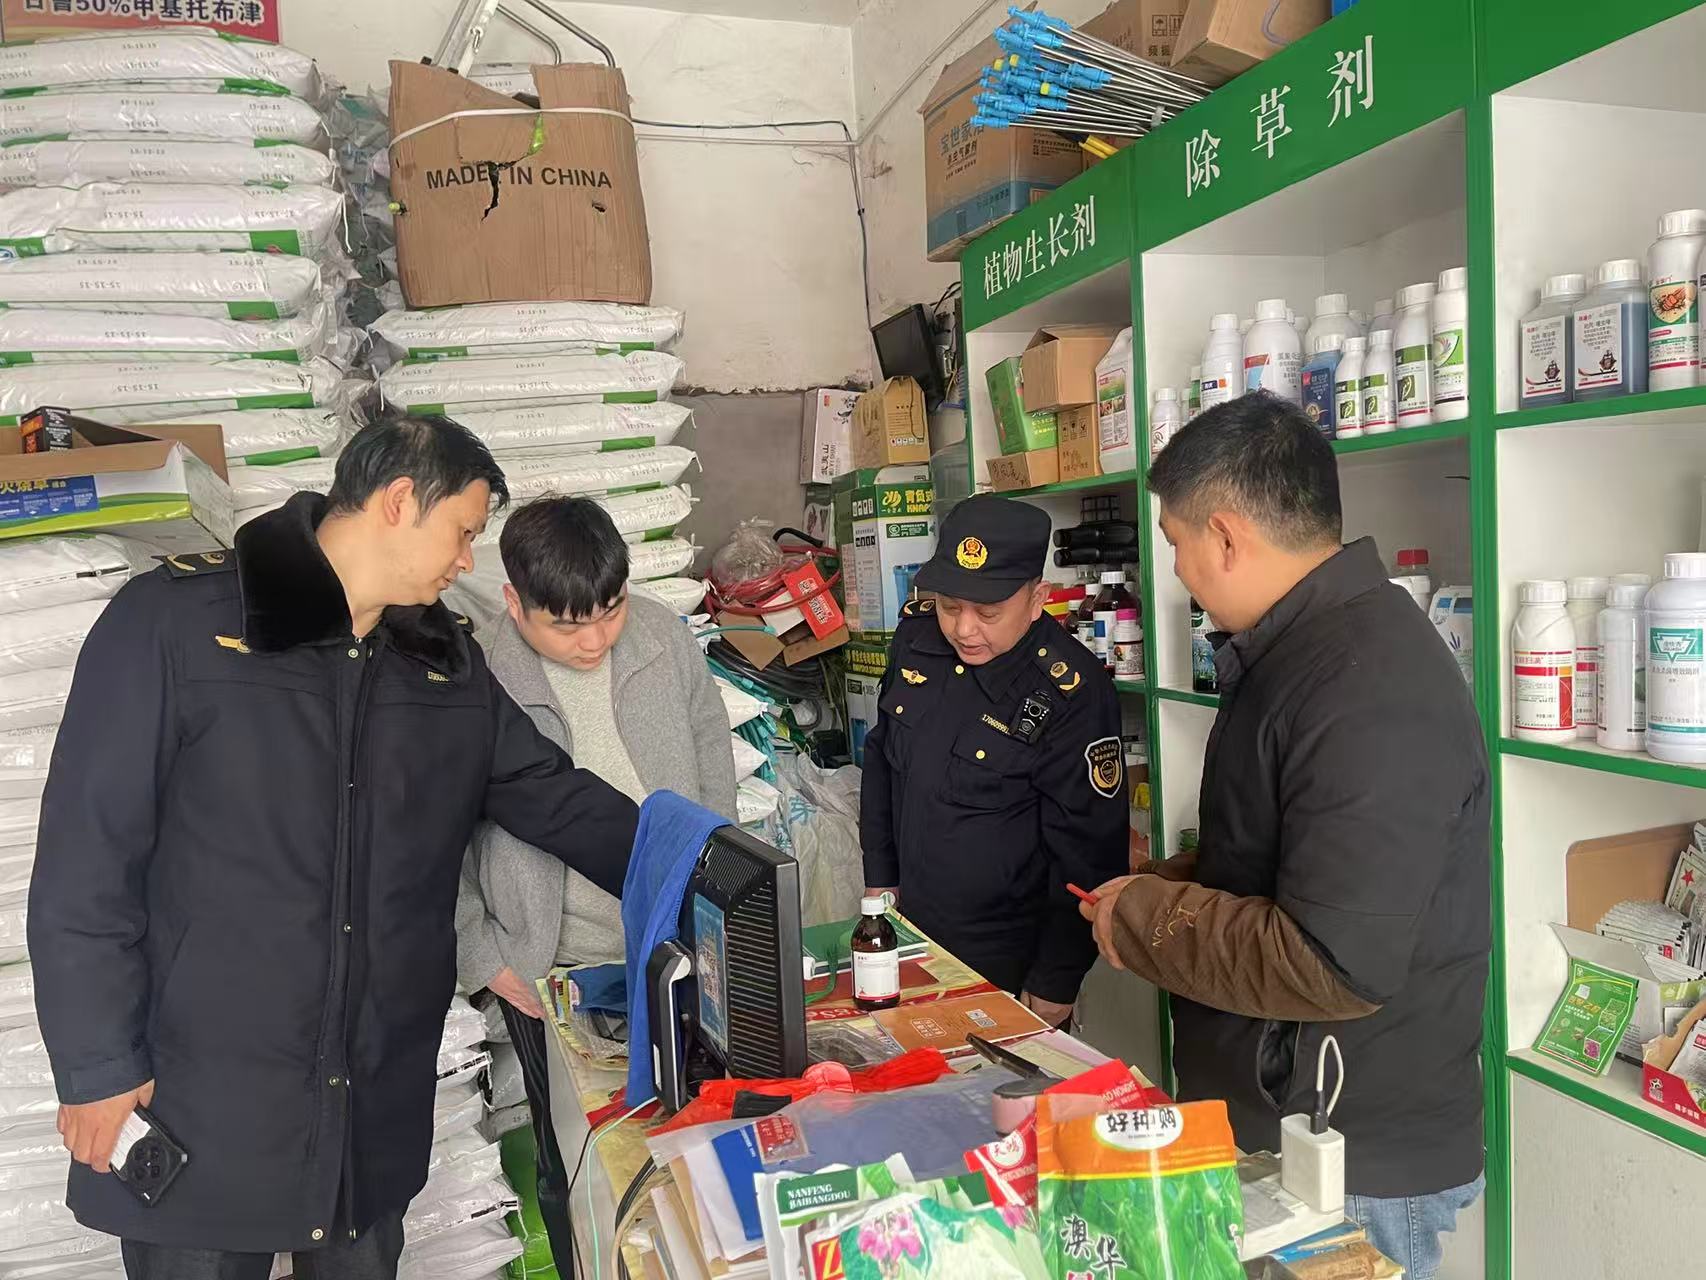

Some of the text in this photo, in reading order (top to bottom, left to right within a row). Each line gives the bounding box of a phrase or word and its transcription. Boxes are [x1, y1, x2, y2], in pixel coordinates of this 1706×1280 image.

[1184, 35, 1374, 199] 除草剂
[426, 164, 612, 190] MADE IN CHINA
[983, 196, 1097, 300] 植物生长剂
